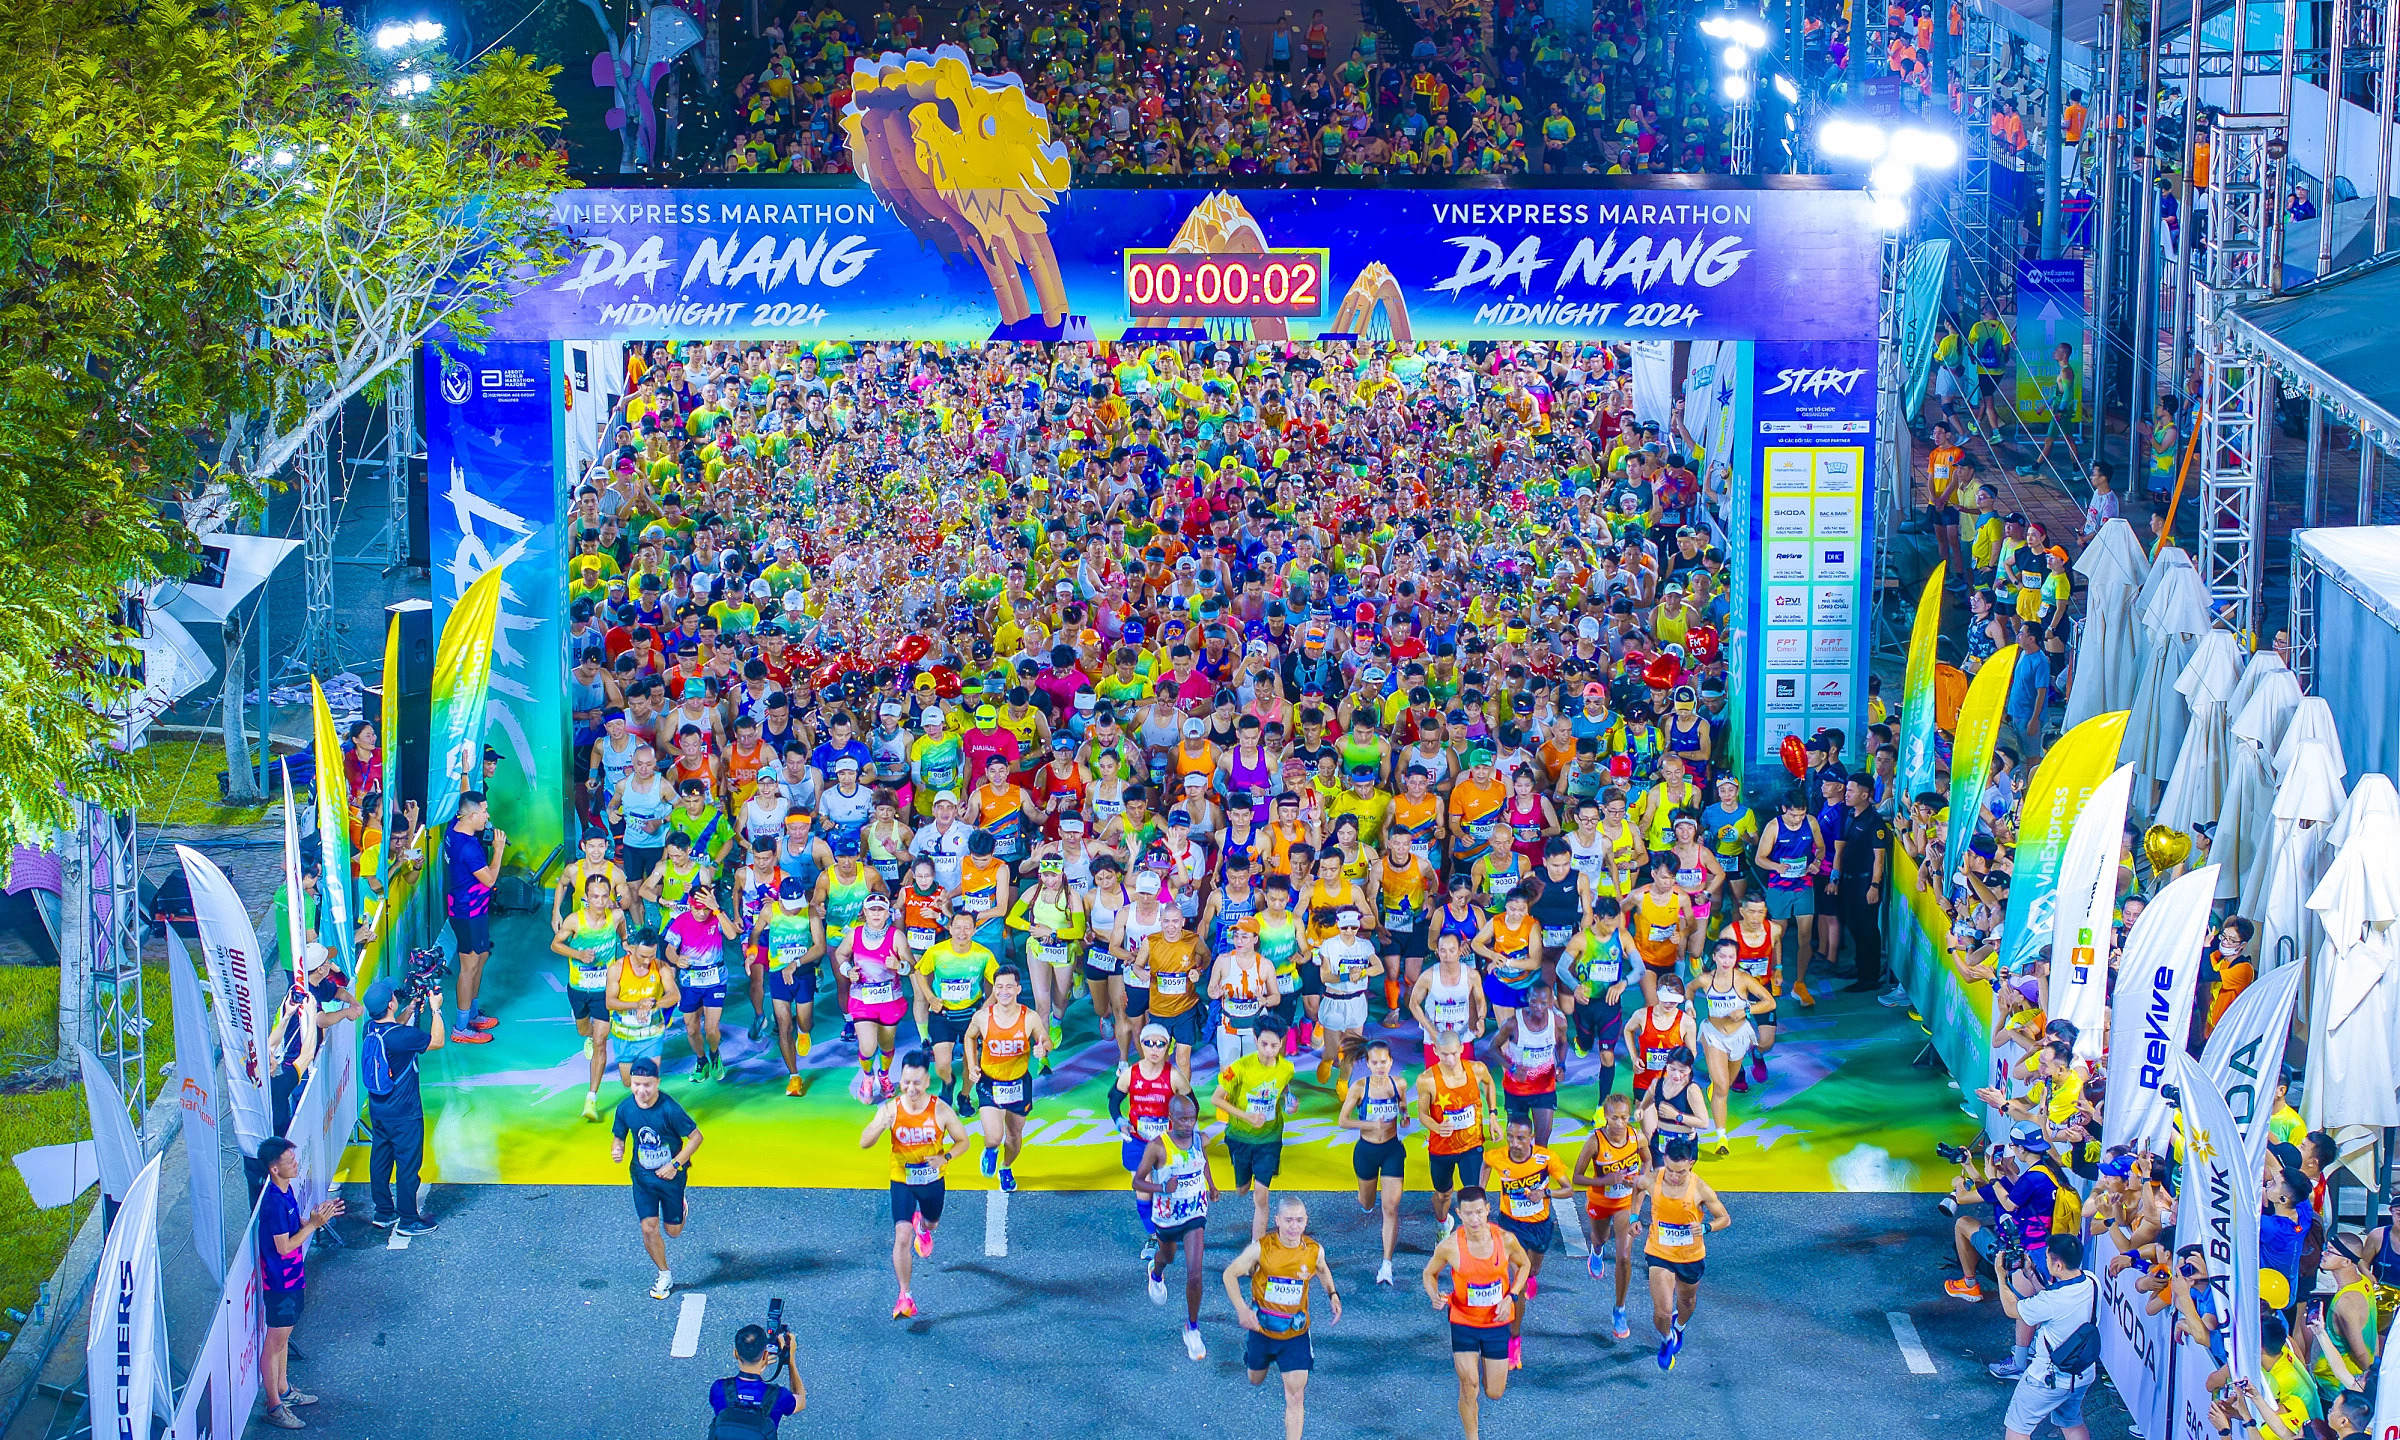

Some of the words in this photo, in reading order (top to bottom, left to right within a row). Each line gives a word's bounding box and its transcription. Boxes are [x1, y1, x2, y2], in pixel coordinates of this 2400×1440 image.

[555, 203, 711, 225] VNEXPRESS
[722, 203, 875, 225] MARATHON
[1432, 203, 1589, 225] VNEXPRESS
[1599, 203, 1752, 225] MARATHON
[553, 230, 679, 295] DA
[681, 230, 881, 290] NANG
[1429, 233, 1552, 296] DA
[1552, 229, 1756, 291] NANG
[1129, 262, 1316, 306] 00:00:02
[751, 303, 828, 328] 2024
[1626, 303, 1703, 330] 2024
[1762, 366, 1870, 399] START
[1776, 638, 1798, 646] FPT
[1821, 638, 1843, 646] FPT
[2035, 786, 2069, 889] VnExpress
[1494, 878, 1517, 886] 90302
[868, 986, 890, 996] 90467
[2139, 966, 2174, 1090] ReVive
[987, 1039, 1025, 1053] QBR
[895, 1126, 937, 1143] QBR
[1178, 1177, 1201, 1189] 99001
[2209, 1167, 2230, 1266] BANK
[1274, 1285, 1301, 1295] 90595
[2103, 1265, 2157, 1384] SKODA
